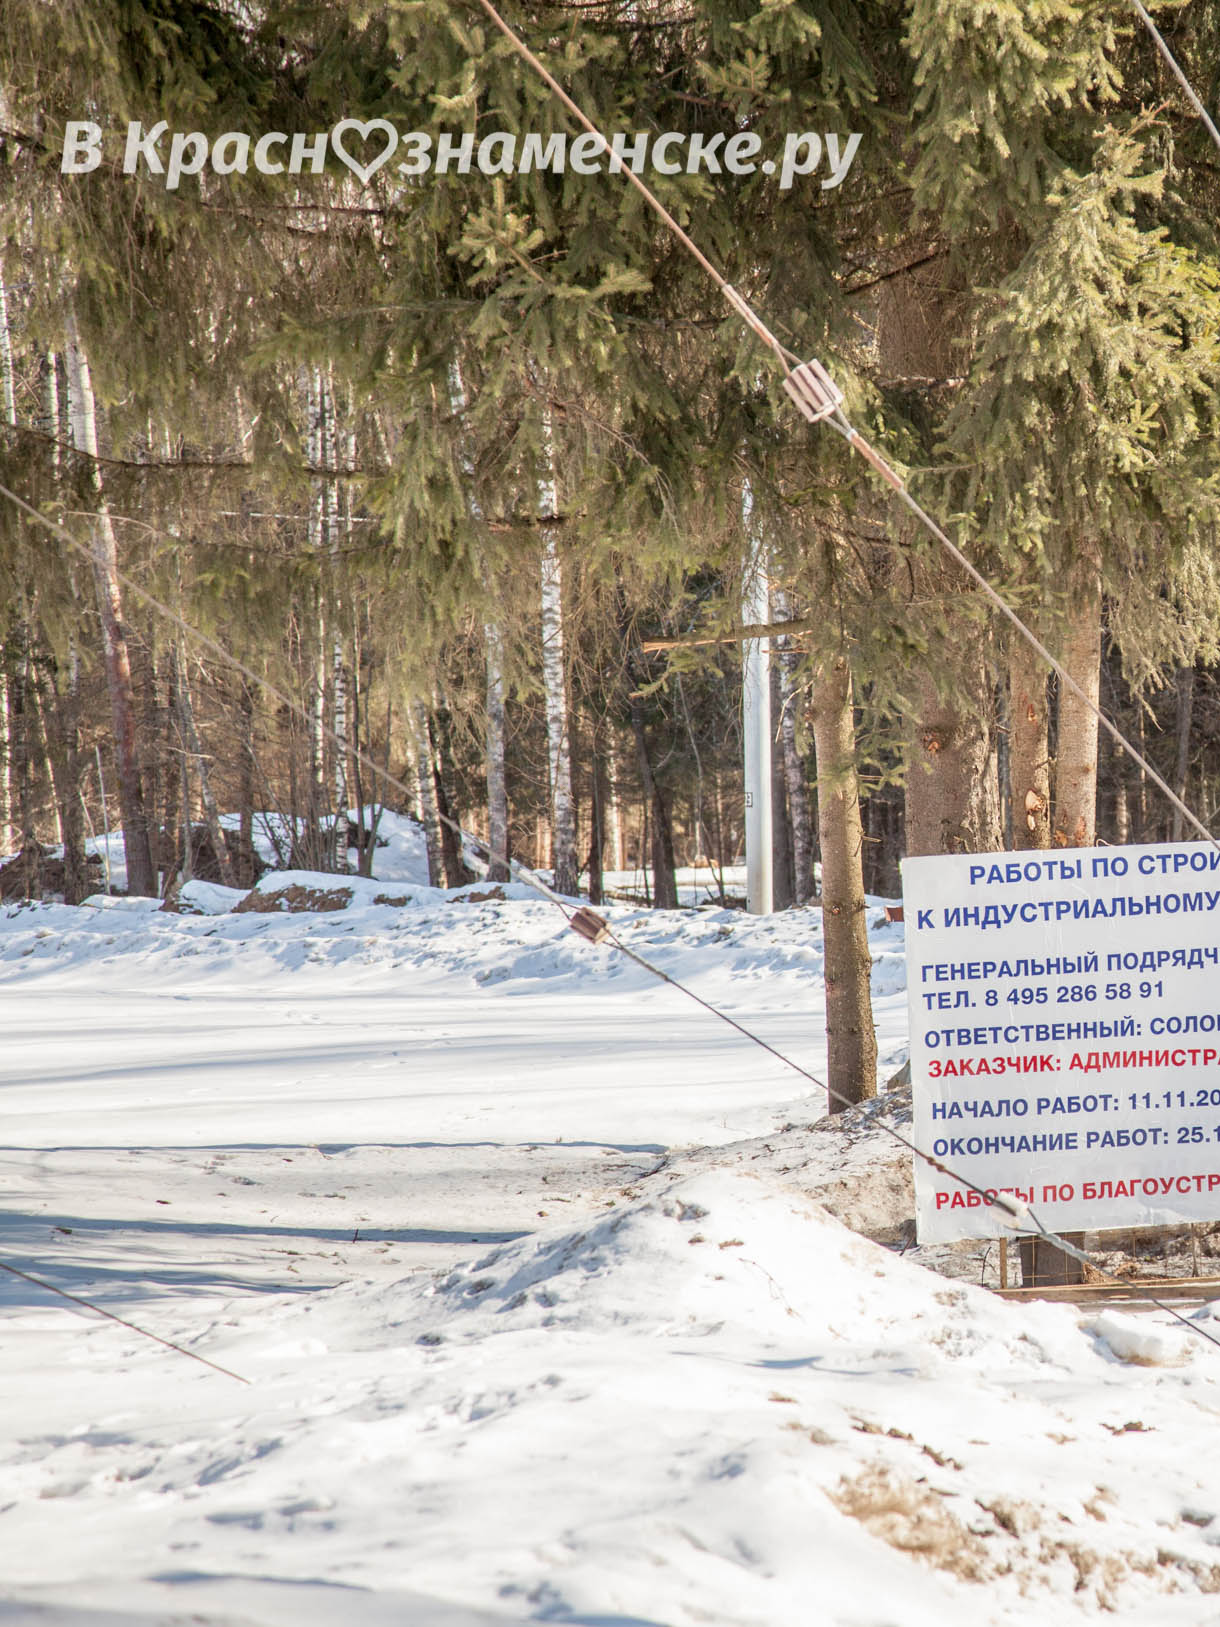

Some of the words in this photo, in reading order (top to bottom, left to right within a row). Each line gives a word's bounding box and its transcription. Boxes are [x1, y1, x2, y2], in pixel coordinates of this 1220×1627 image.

[969, 859, 1082, 886] РАБОТЫ
[1091, 856, 1129, 878] ПО
[917, 909, 935, 929] К
[944, 890, 1220, 930] ИНДУСТРИАЛЬНОМУ
[921, 951, 1099, 983] ГЕНЕРАЛЬНЫЙ
[922, 990, 977, 1011] ТЕЛ.
[985, 989, 999, 1007] 8
[1007, 986, 1049, 1006] 495
[1056, 984, 1097, 1003] 286
[1105, 982, 1132, 1001] 58
[1139, 980, 1163, 999] 91
[924, 1015, 1142, 1049] ОТВЕТСТВЕННЫЙ:
[928, 1054, 1061, 1078] ЗАКАЗЧИК:
[932, 1098, 1028, 1120] НАЧАЛО
[1036, 1094, 1118, 1115] РАБОТ:
[933, 1132, 1078, 1156] ОКОНЧАНИЕ
[1087, 1127, 1169, 1149] РАБОТ:
[1042, 1183, 1075, 1203] ПО
